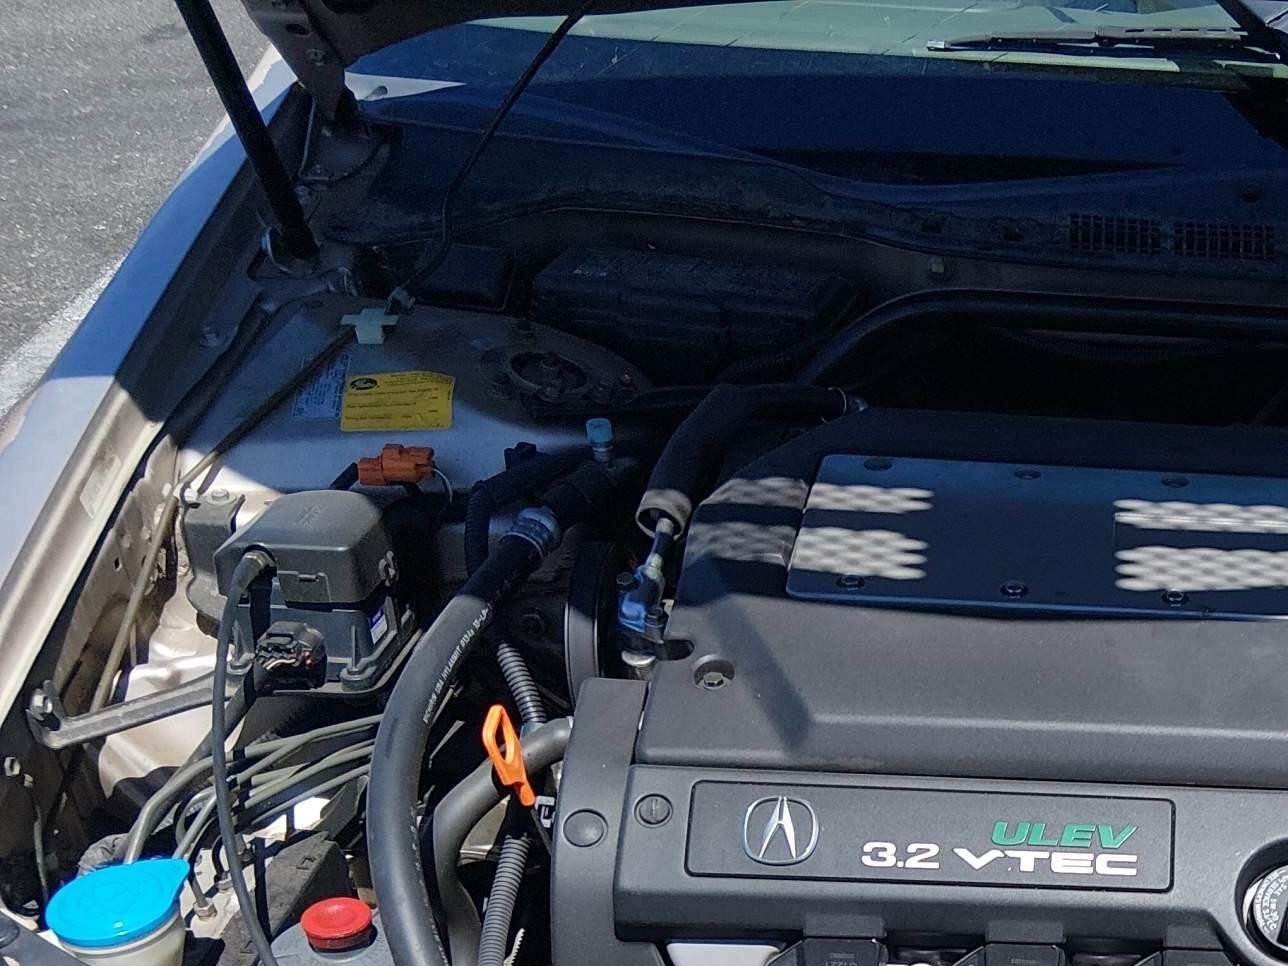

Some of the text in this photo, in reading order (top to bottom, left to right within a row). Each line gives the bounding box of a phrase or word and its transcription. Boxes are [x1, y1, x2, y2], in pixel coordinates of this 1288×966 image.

[991, 821, 1138, 848] ULEV
[861, 841, 1138, 876] 3.2 VTEC
